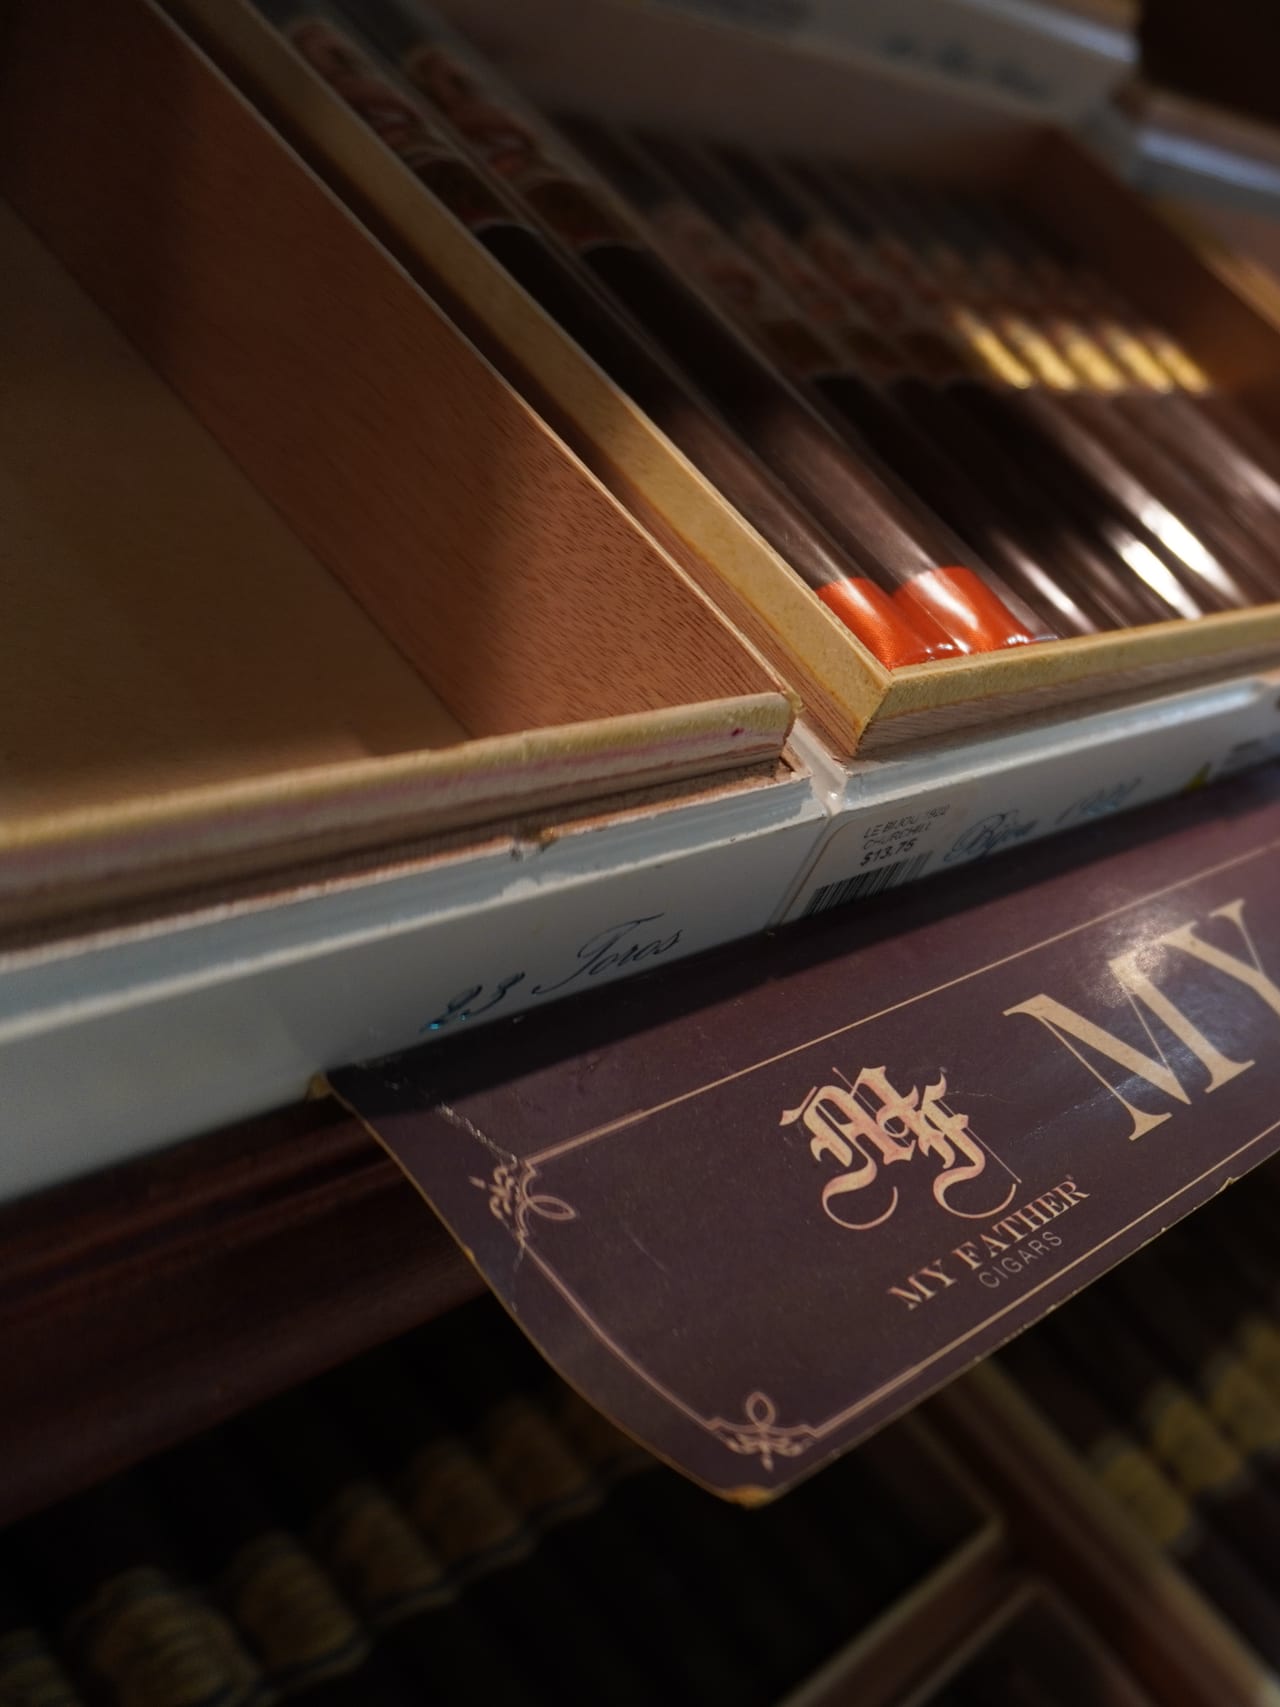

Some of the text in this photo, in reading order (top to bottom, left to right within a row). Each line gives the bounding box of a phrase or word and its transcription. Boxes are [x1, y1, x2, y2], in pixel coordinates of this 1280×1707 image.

[860, 837, 919, 867] $13.75
[863, 823, 884, 839] LE
[531, 912, 684, 995] Toros
[888, 1178, 1092, 1311] MY FATHER
[978, 1230, 1063, 1290] CIGARS
